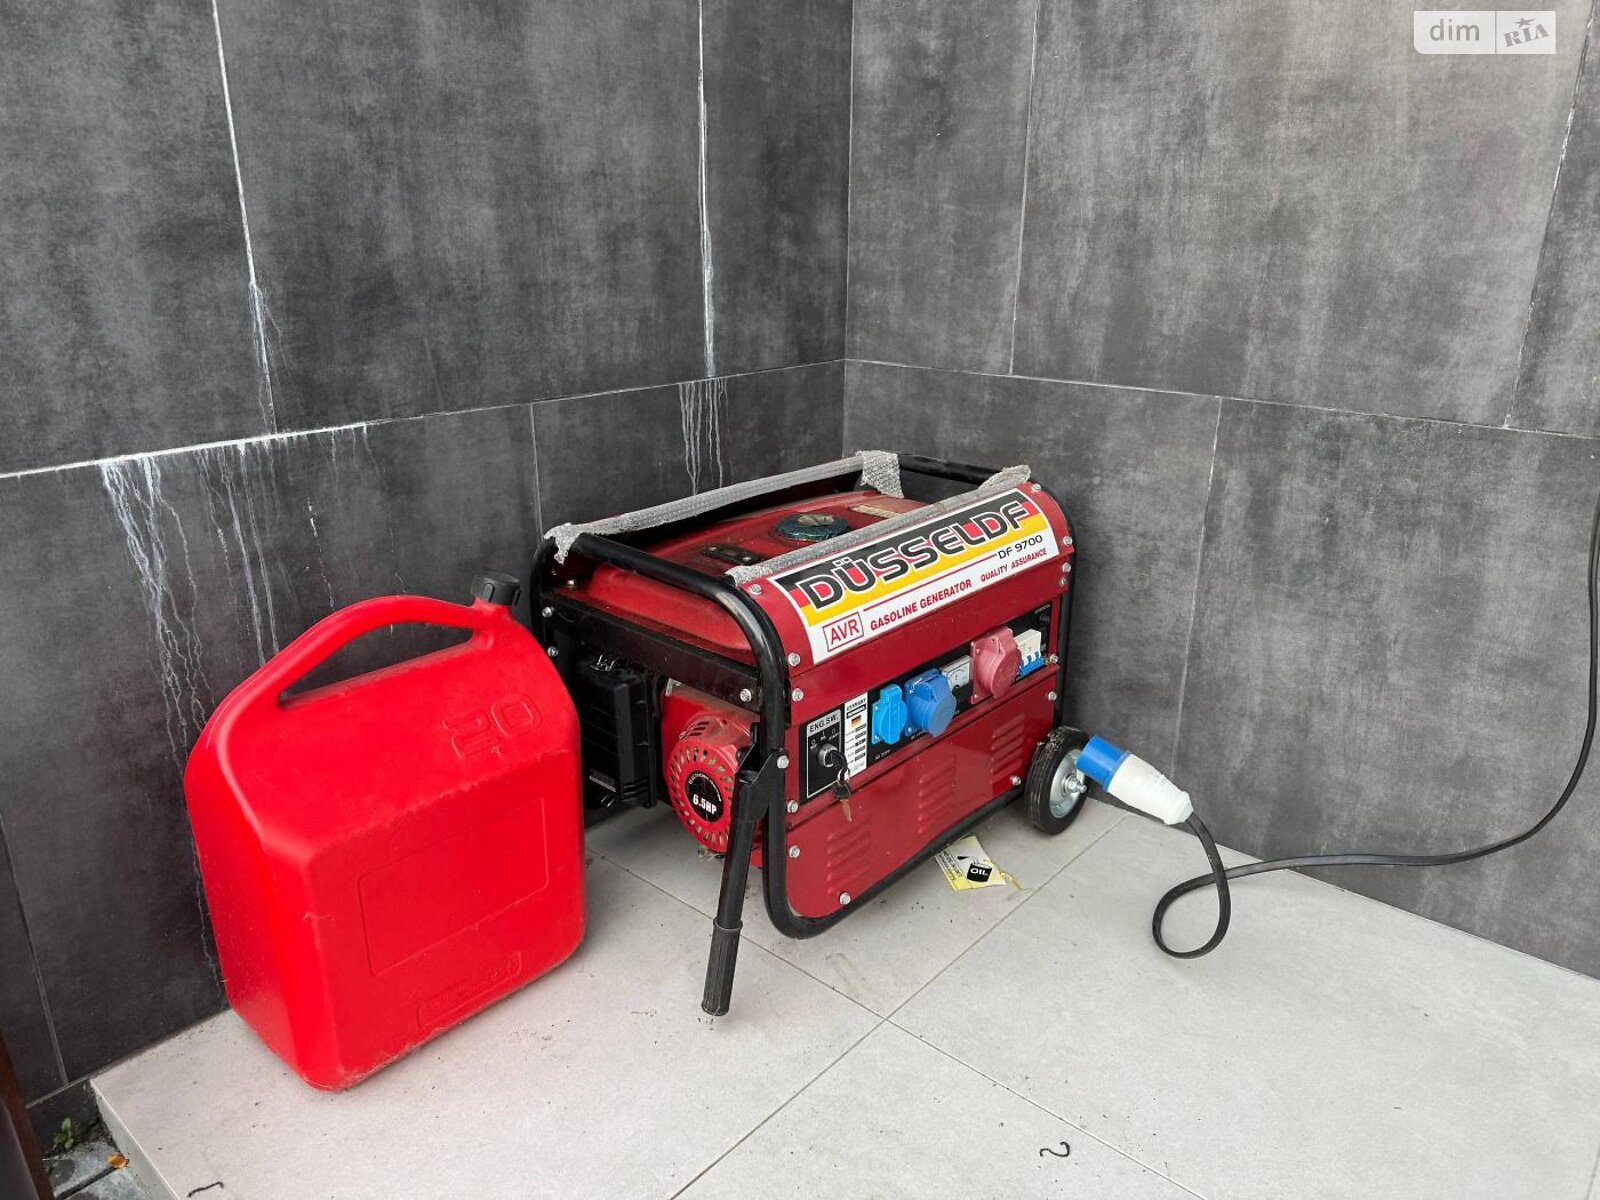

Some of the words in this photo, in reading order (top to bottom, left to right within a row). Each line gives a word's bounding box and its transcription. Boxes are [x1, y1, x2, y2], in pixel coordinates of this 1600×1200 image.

[798, 498, 1029, 612] DÜSSELDF
[997, 546, 1014, 560] DF
[1014, 534, 1043, 552] 9700
[980, 563, 1008, 582] QUALITY
[1010, 547, 1048, 570] ASSURANCE
[870, 601, 918, 631] GASOLINE
[919, 578, 972, 609] GENERATOR
[830, 618, 860, 646] AVR
[440, 693, 543, 759] 20
[693, 793, 718, 815] 6.5HP
[970, 867, 989, 876] OIL
